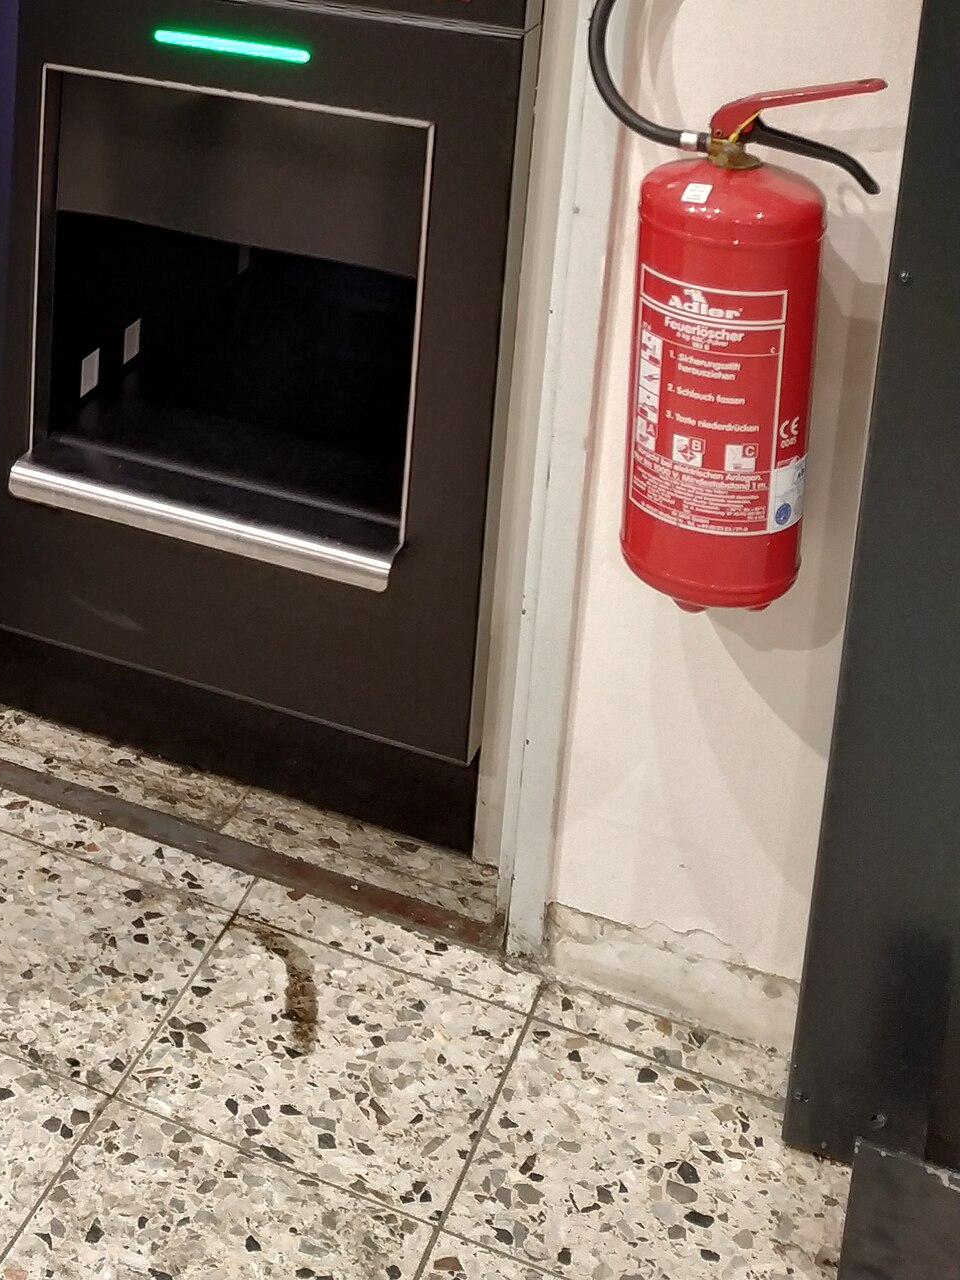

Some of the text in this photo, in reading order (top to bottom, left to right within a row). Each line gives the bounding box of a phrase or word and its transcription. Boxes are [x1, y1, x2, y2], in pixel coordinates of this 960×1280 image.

[668, 295, 743, 319] Adler
[664, 317, 744, 342] Feuerlöscher
[669, 350, 676, 360] 1.
[667, 383, 675, 393] 2.
[677, 386, 715, 403] Schlauch
[665, 410, 674, 419] 3.
[692, 440, 702, 452] B
[744, 446, 755, 457] C
